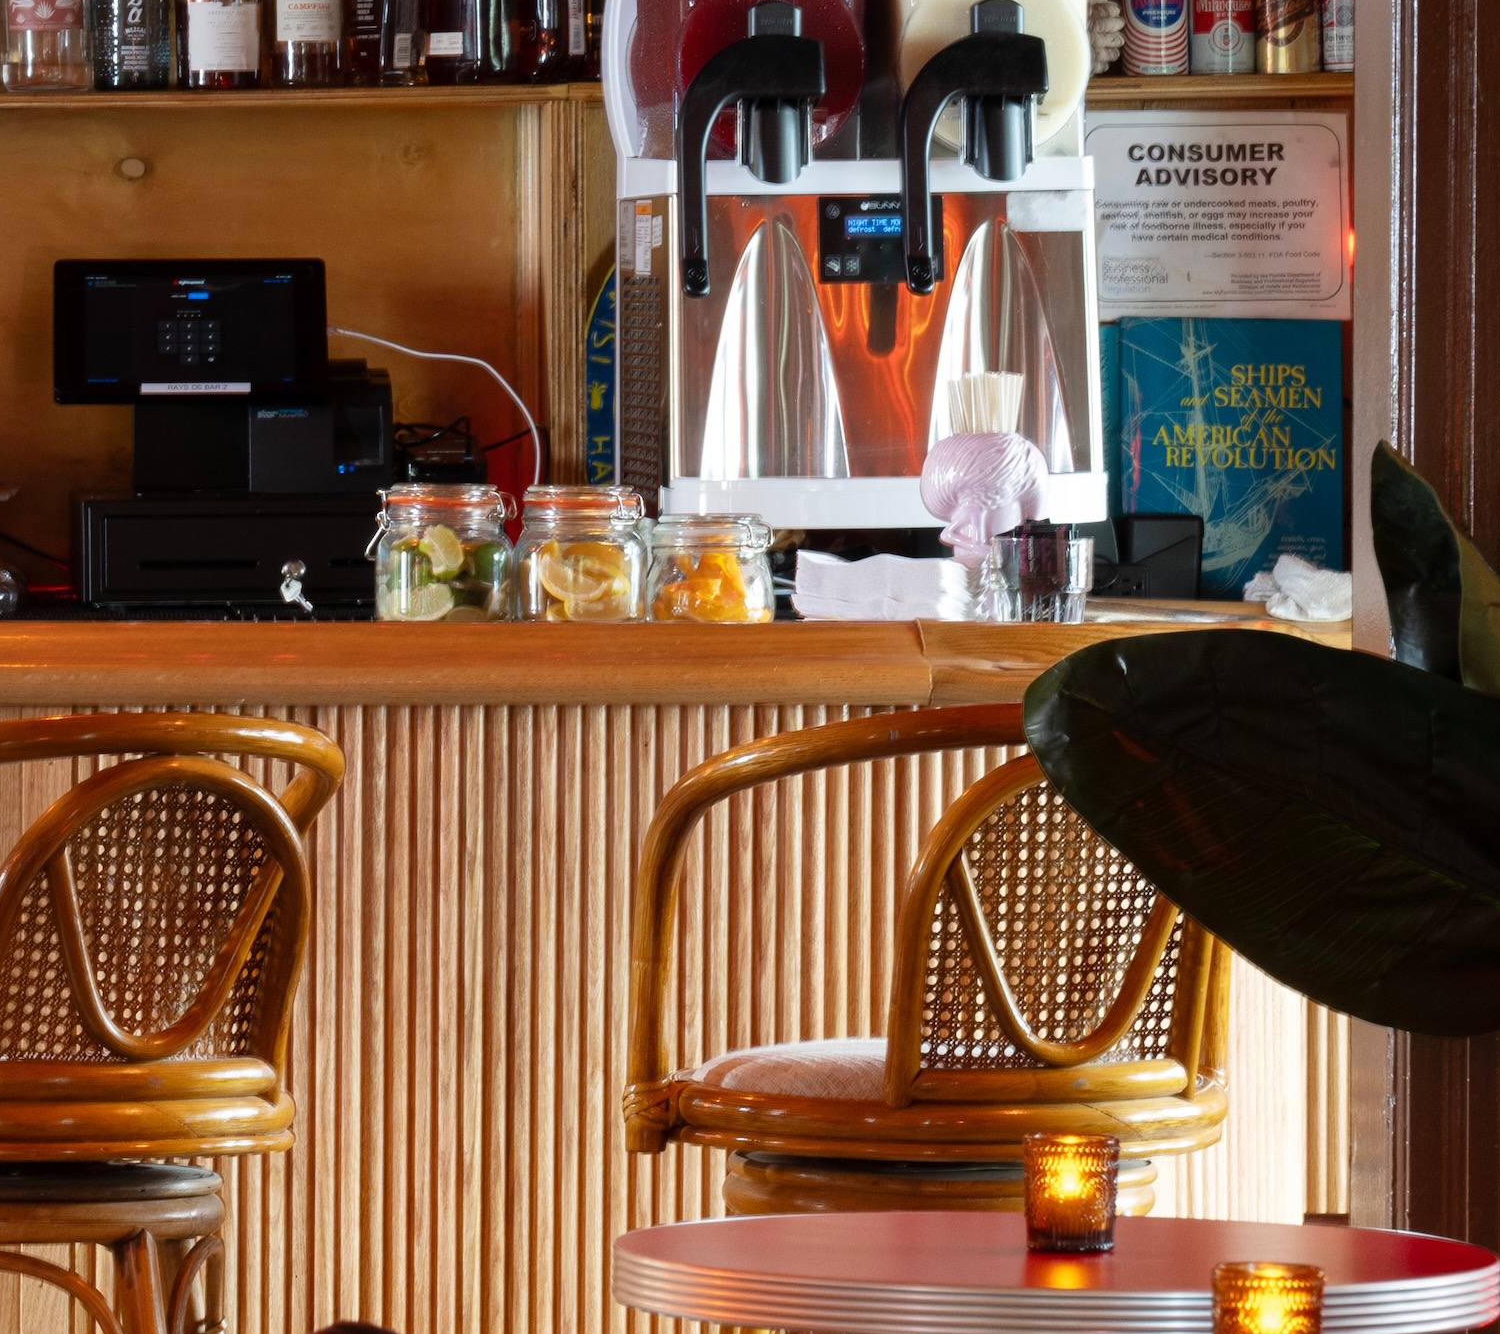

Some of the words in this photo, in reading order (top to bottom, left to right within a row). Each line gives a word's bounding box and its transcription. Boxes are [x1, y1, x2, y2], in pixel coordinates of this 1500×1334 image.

[287, 2, 331, 11] CAMPFIRE
[124, 26, 147, 35] MEZCAL
[1127, 142, 1285, 163] CONSUMER
[1134, 166, 1279, 187] ADVISORY
[868, 201, 901, 210] BUNN
[1095, 199, 1150, 211] Consuming
[1151, 201, 1169, 209] raw
[1183, 199, 1246, 208] undercooked
[1248, 199, 1280, 209] meats,
[1282, 198, 1319, 209] poultry,
[1100, 210, 1141, 221] seafood,
[1143, 210, 1186, 220] shellfish,
[1201, 212, 1225, 221] eggs
[1226, 212, 1247, 220] may
[1249, 210, 1290, 219] increase
[1291, 210, 1315, 220] your
[848, 218, 868, 226] NIGHT
[872, 218, 887, 226] TIME
[1109, 222, 1127, 231] risk
[1129, 222, 1141, 230] of
[1141, 221, 1190, 231] foodborne
[1192, 221, 1227, 231] illness,
[1228, 221, 1277, 232] especially
[1286, 222, 1305, 231] you
[1131, 233, 1154, 242] have
[1156, 232, 1189, 242] certain
[1191, 232, 1229, 241] medical
[1231, 232, 1284, 241] conditions.
[1102, 260, 1151, 273] Business
[1102, 272, 1169, 284] Professional
[1102, 285, 1151, 294] Regulation
[1230, 363, 1306, 386] SHIPS
[1179, 392, 1211, 407] and
[1213, 386, 1323, 409] SEAMEN
[1240, 407, 1260, 430] of
[1261, 408, 1285, 424] the
[1152, 424, 1292, 448] AMERICAN
[1165, 446, 1337, 470] REVOLUTION
